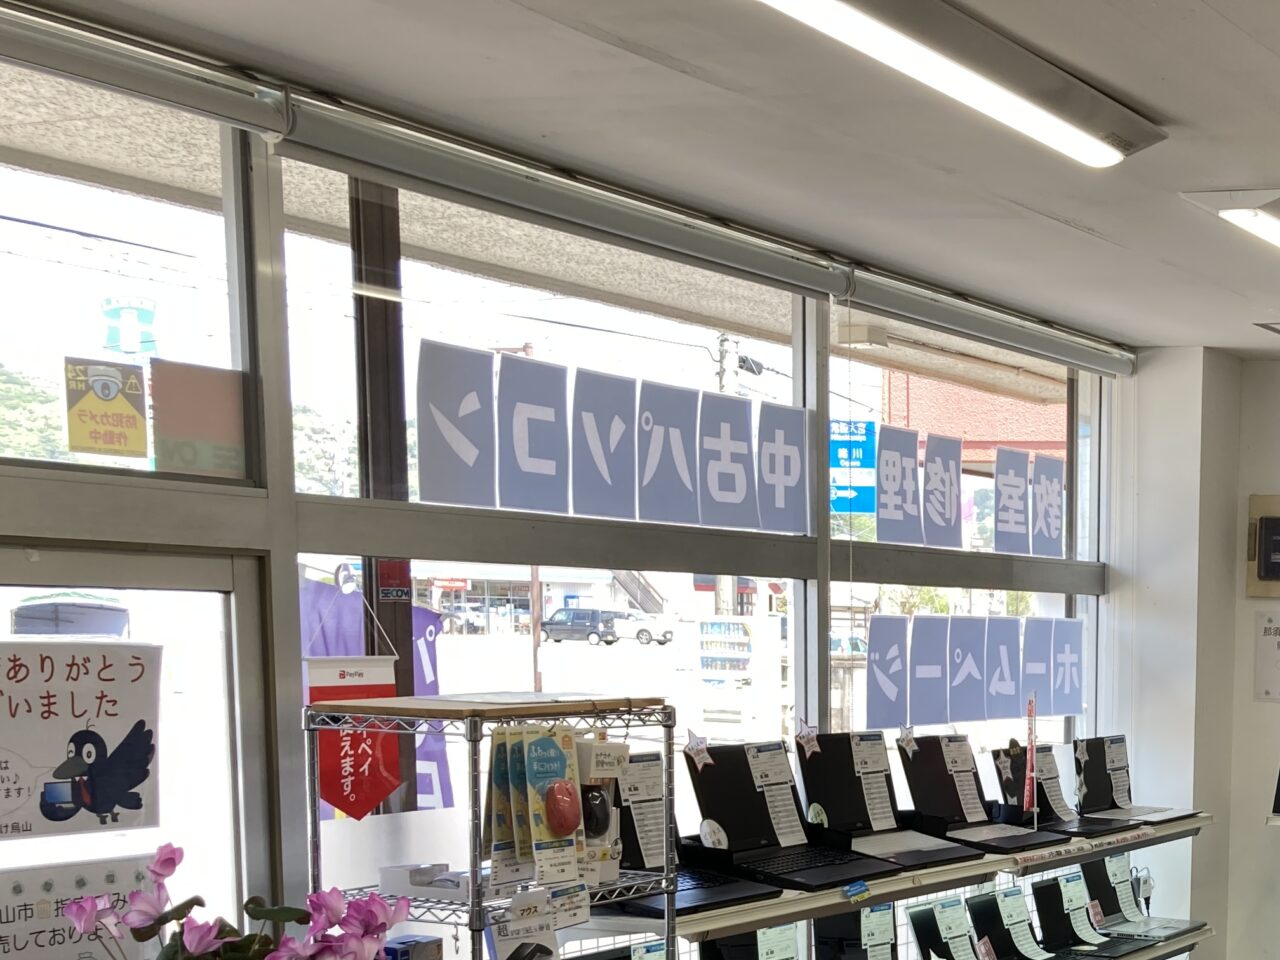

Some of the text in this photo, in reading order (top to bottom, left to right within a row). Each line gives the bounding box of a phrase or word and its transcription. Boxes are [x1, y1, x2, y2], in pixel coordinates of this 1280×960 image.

[380, 588, 410, 599] SECOM
[5, 653, 146, 684] ありがとう
[345, 670, 364, 679] PayPay
[0, 689, 120, 721] いました
[520, 905, 538, 917] マウス
